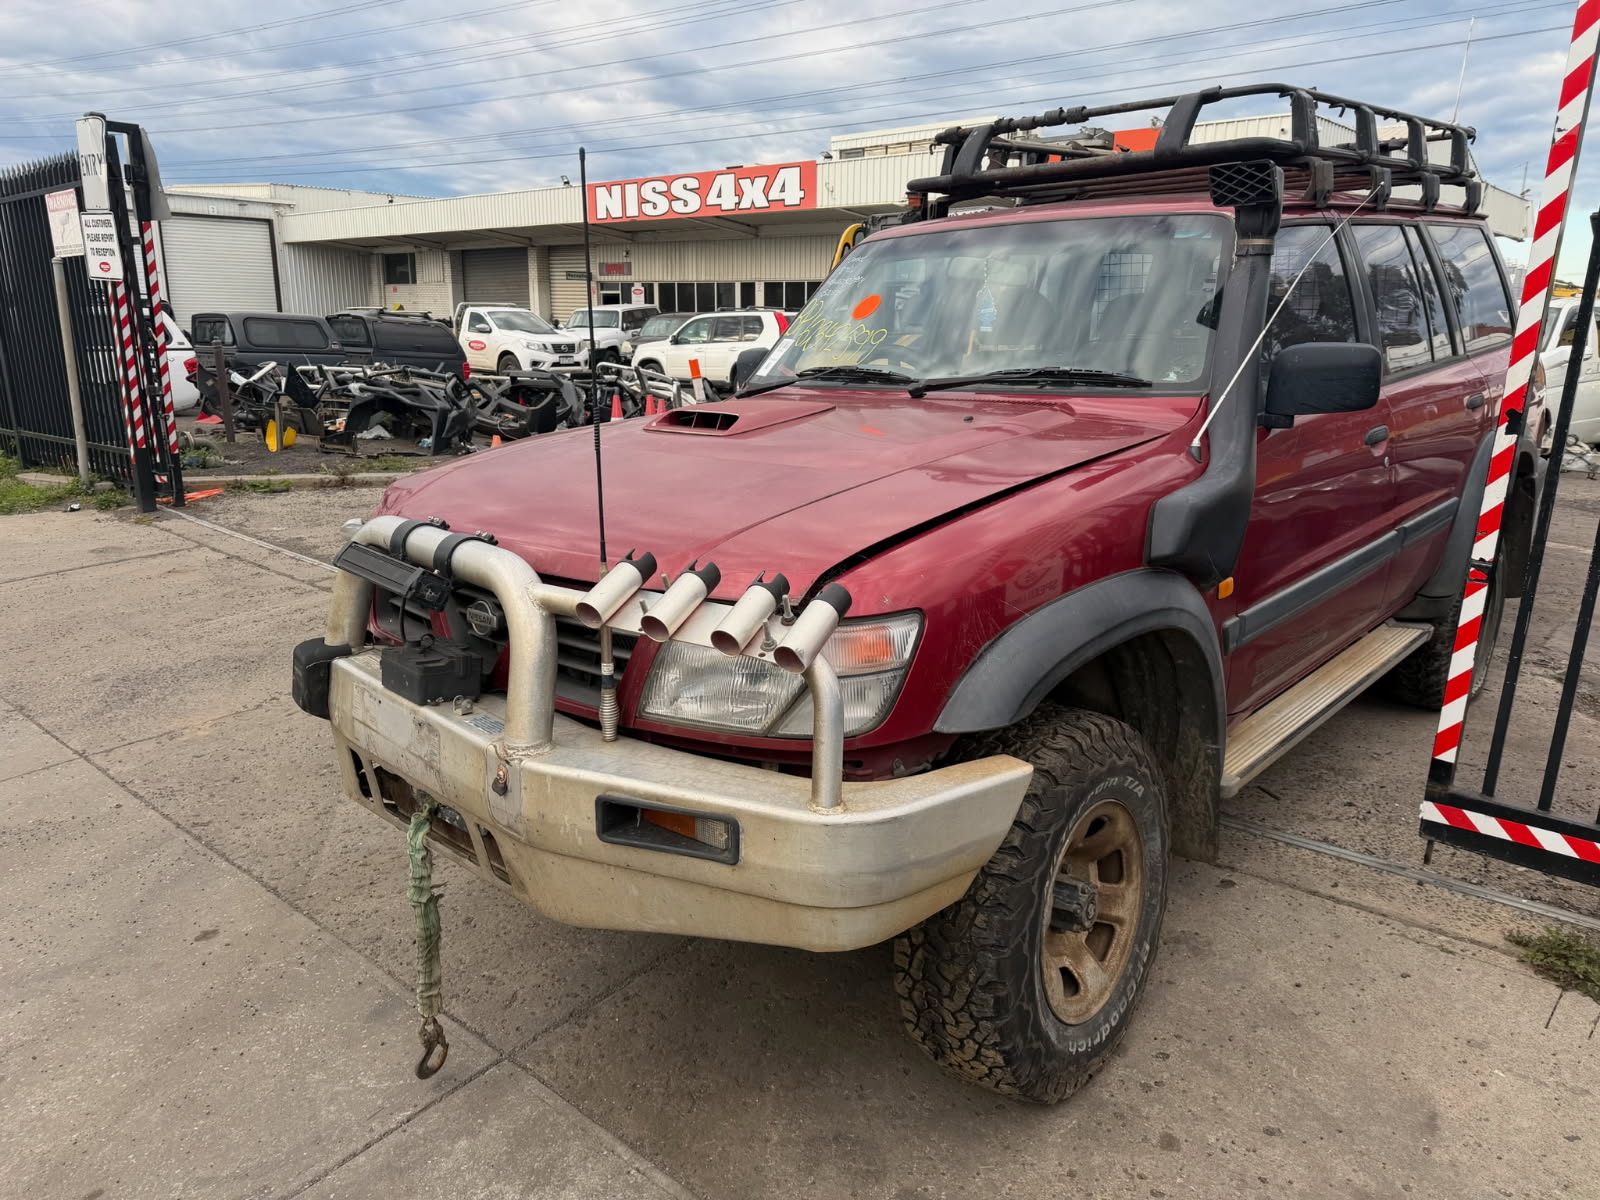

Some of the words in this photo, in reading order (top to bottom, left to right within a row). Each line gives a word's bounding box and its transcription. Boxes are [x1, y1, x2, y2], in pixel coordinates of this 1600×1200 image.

[81, 153, 103, 177] ENTRY
[92, 219, 113, 228] CUSTOMERS
[86, 233, 101, 242] PLEASE
[101, 233, 115, 242] REPORT
[90, 247, 96, 256] TO
[95, 247, 116, 257] RECEPTION
[468, 609, 495, 627] NISSAN
[1123, 775, 1146, 799] T/A
[1068, 941, 1151, 1056] BFGoodrich
